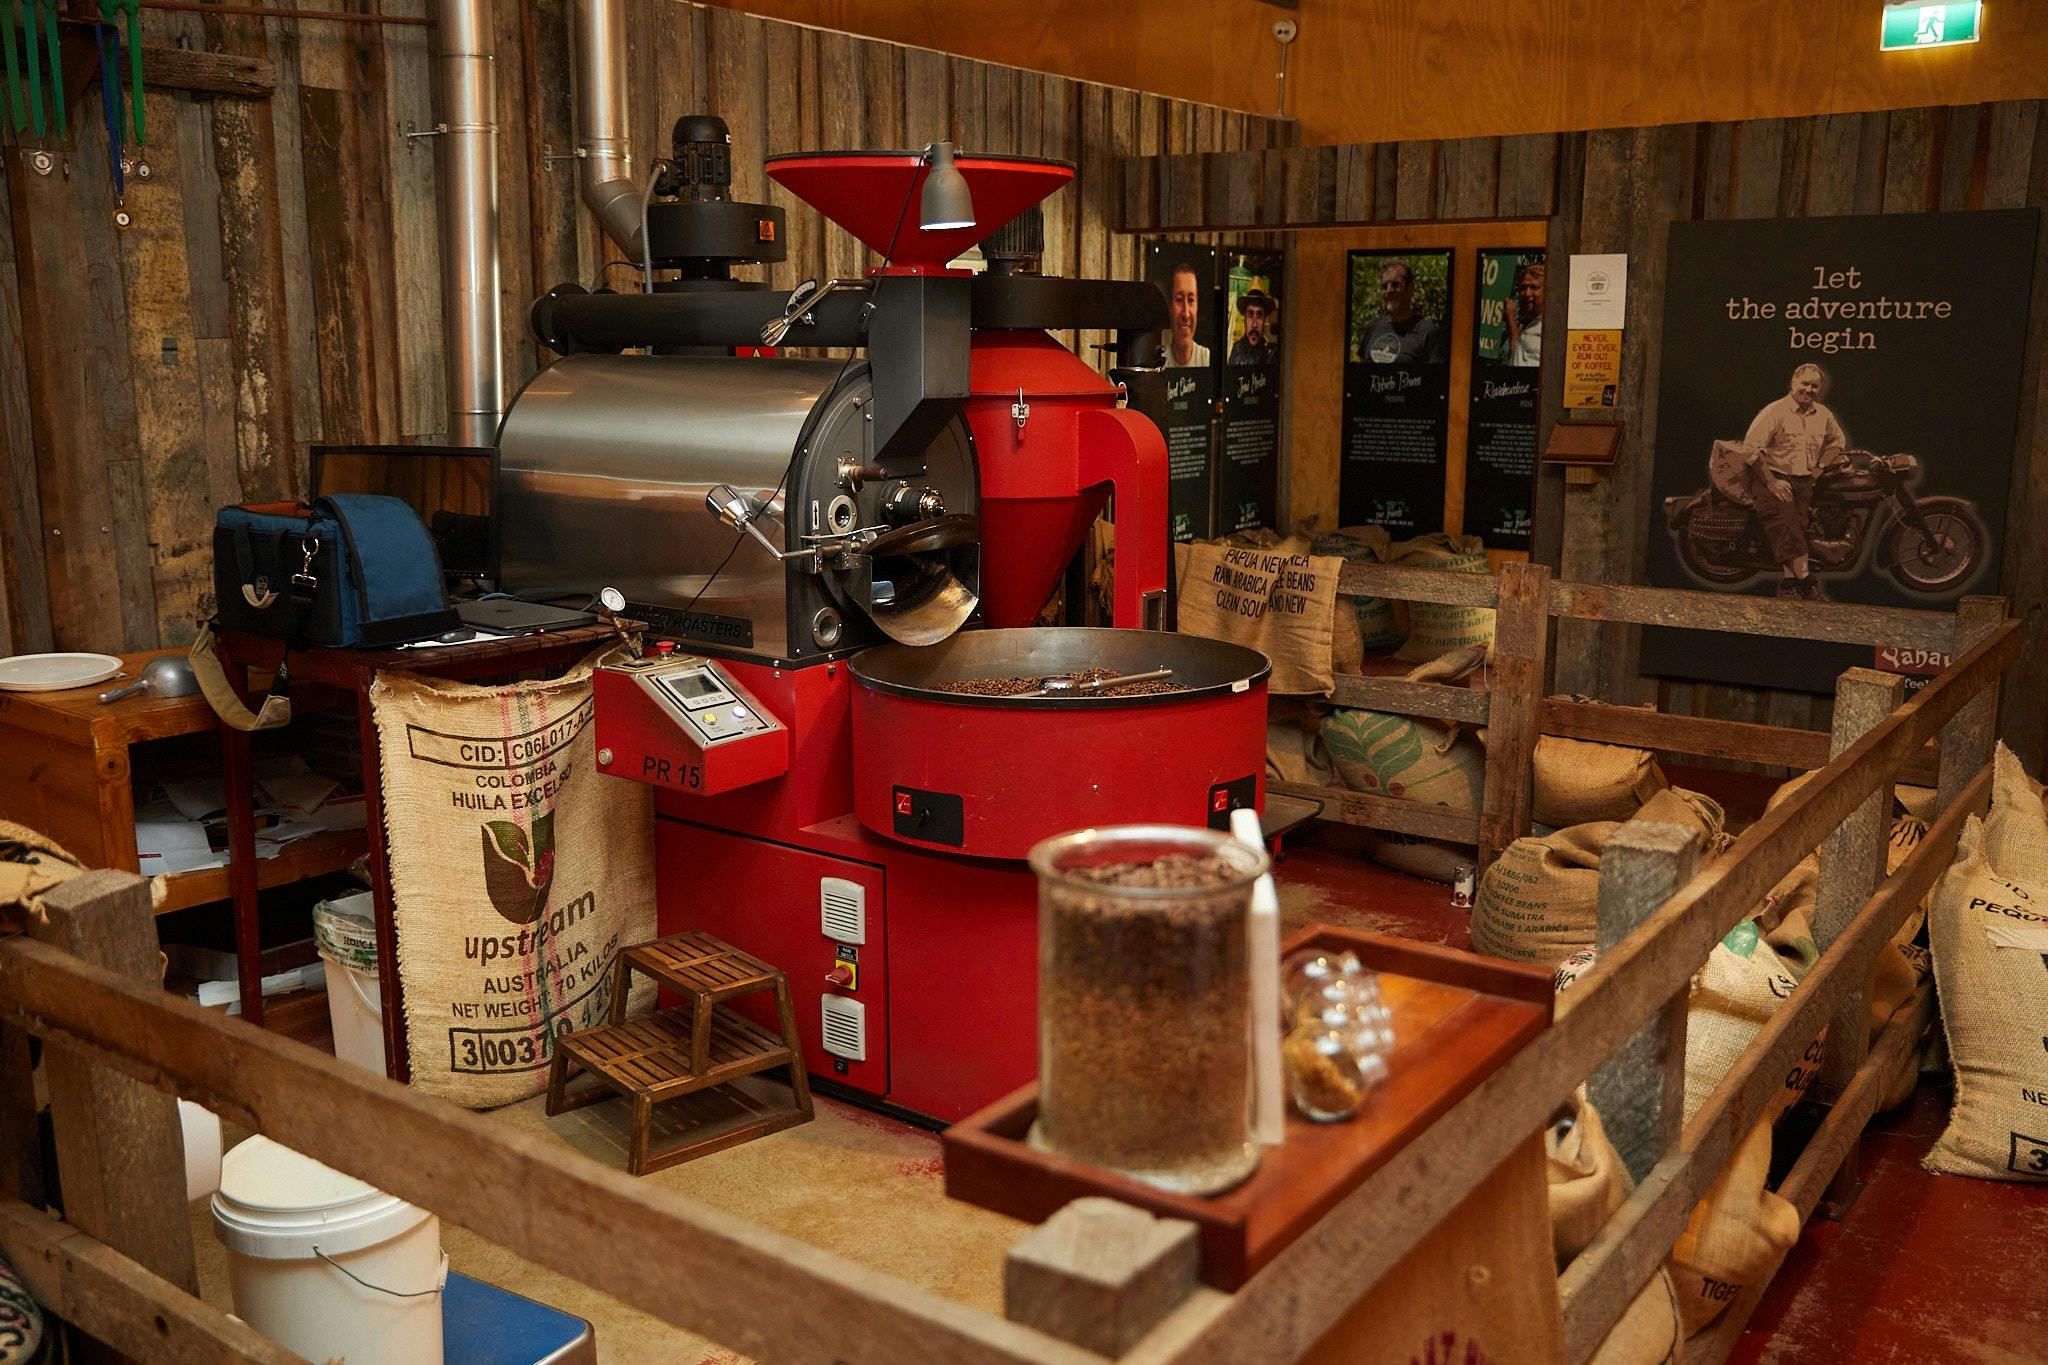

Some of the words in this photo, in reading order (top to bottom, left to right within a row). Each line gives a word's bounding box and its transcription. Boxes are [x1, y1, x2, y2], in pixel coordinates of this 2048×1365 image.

[1812, 266, 1862, 290] let
[1725, 297, 1776, 321] the
[1785, 296, 1952, 321] adventure
[1789, 327, 1877, 354] begin
[1571, 361, 1583, 370] OF
[1593, 352, 1608, 361] OUT
[1225, 549, 1257, 570] PAPUA
[1213, 565, 1232, 585] RAW
[1233, 569, 1268, 596] ARABICA
[1286, 571, 1316, 592] BEANS
[1216, 590, 1241, 613] CLEAN
[1285, 595, 1308, 615] NEW
[460, 744, 503, 763] CID:
[476, 760, 557, 789] COLOMBIA
[642, 755, 671, 783] PR
[678, 763, 701, 789] 15
[452, 791, 507, 810] HUILA
[1500, 907, 1545, 921] SUMATRA
[1969, 897, 2048, 922] PEQU
[465, 890, 596, 967] upstream
[452, 1002, 479, 1019] NET
[558, 974, 576, 995] 70
[580, 933, 618, 982] KILOS
[484, 941, 588, 994] AUSTRALIA
